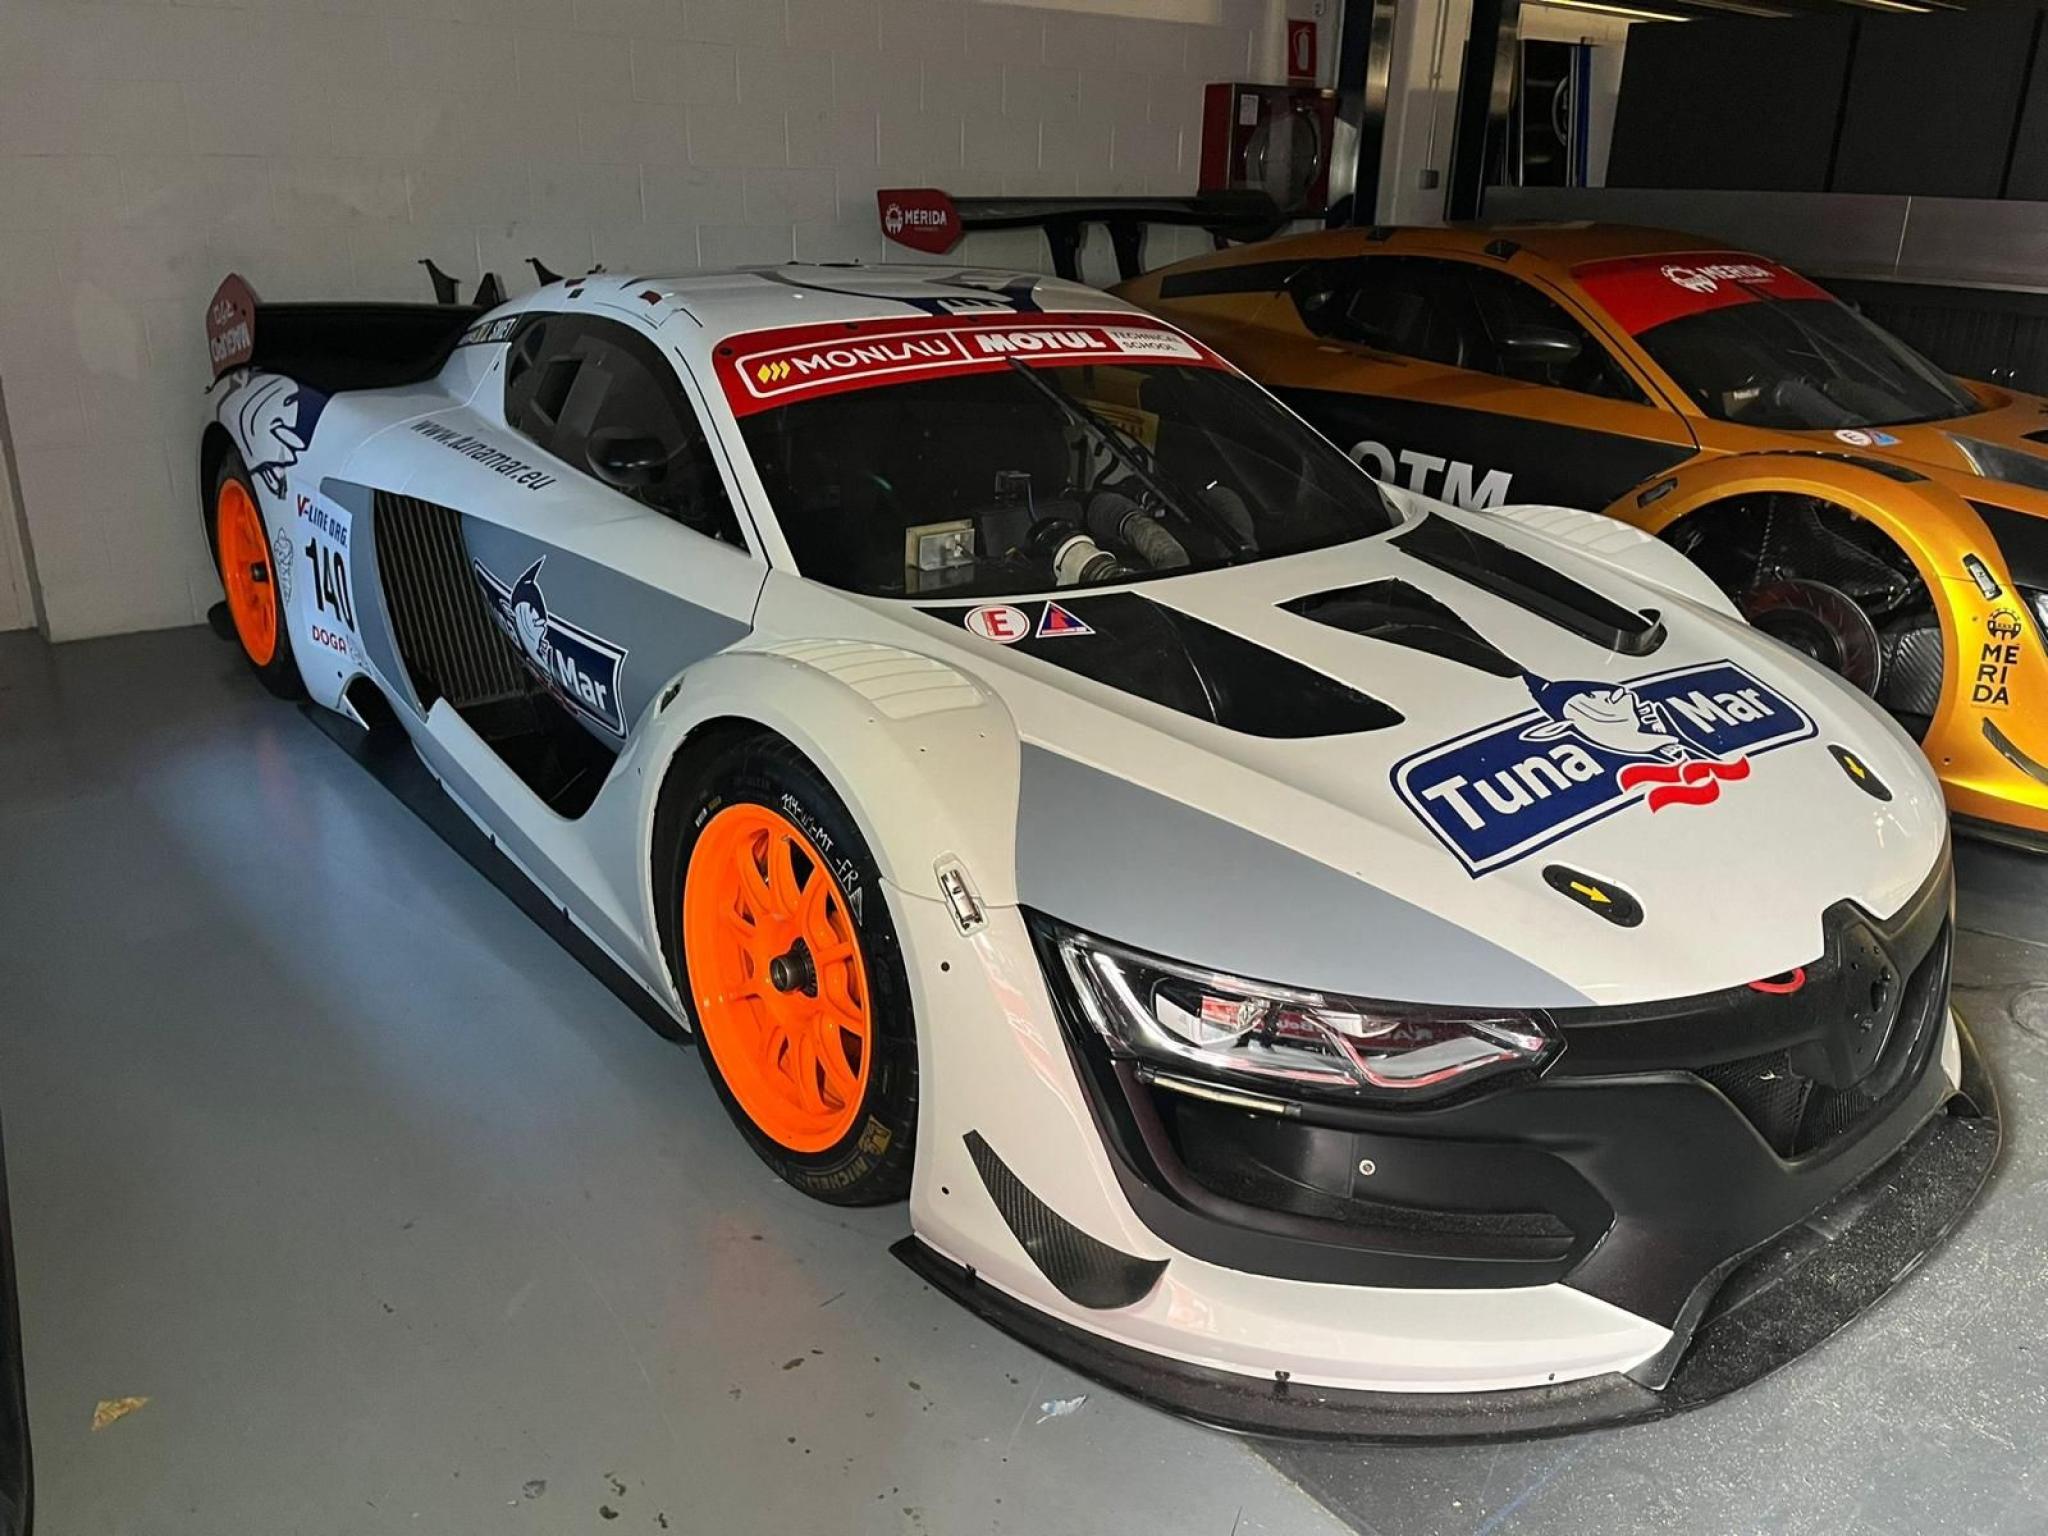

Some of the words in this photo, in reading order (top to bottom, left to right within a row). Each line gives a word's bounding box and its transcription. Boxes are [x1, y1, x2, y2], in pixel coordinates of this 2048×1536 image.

[791, 338, 951, 375] MONLAU
[974, 331, 1107, 353] MOTUL
[1122, 341, 1178, 352] SCHOOL
[410, 419, 557, 491] www.tunamar.eu
[297, 493, 328, 532] V-LINE
[305, 536, 355, 633] 140
[312, 624, 347, 655] DOGA
[981, 608, 1014, 636] E
[554, 648, 607, 711] Mar
[1422, 743, 1605, 831] Tuna
[1669, 687, 1776, 735] Mar
